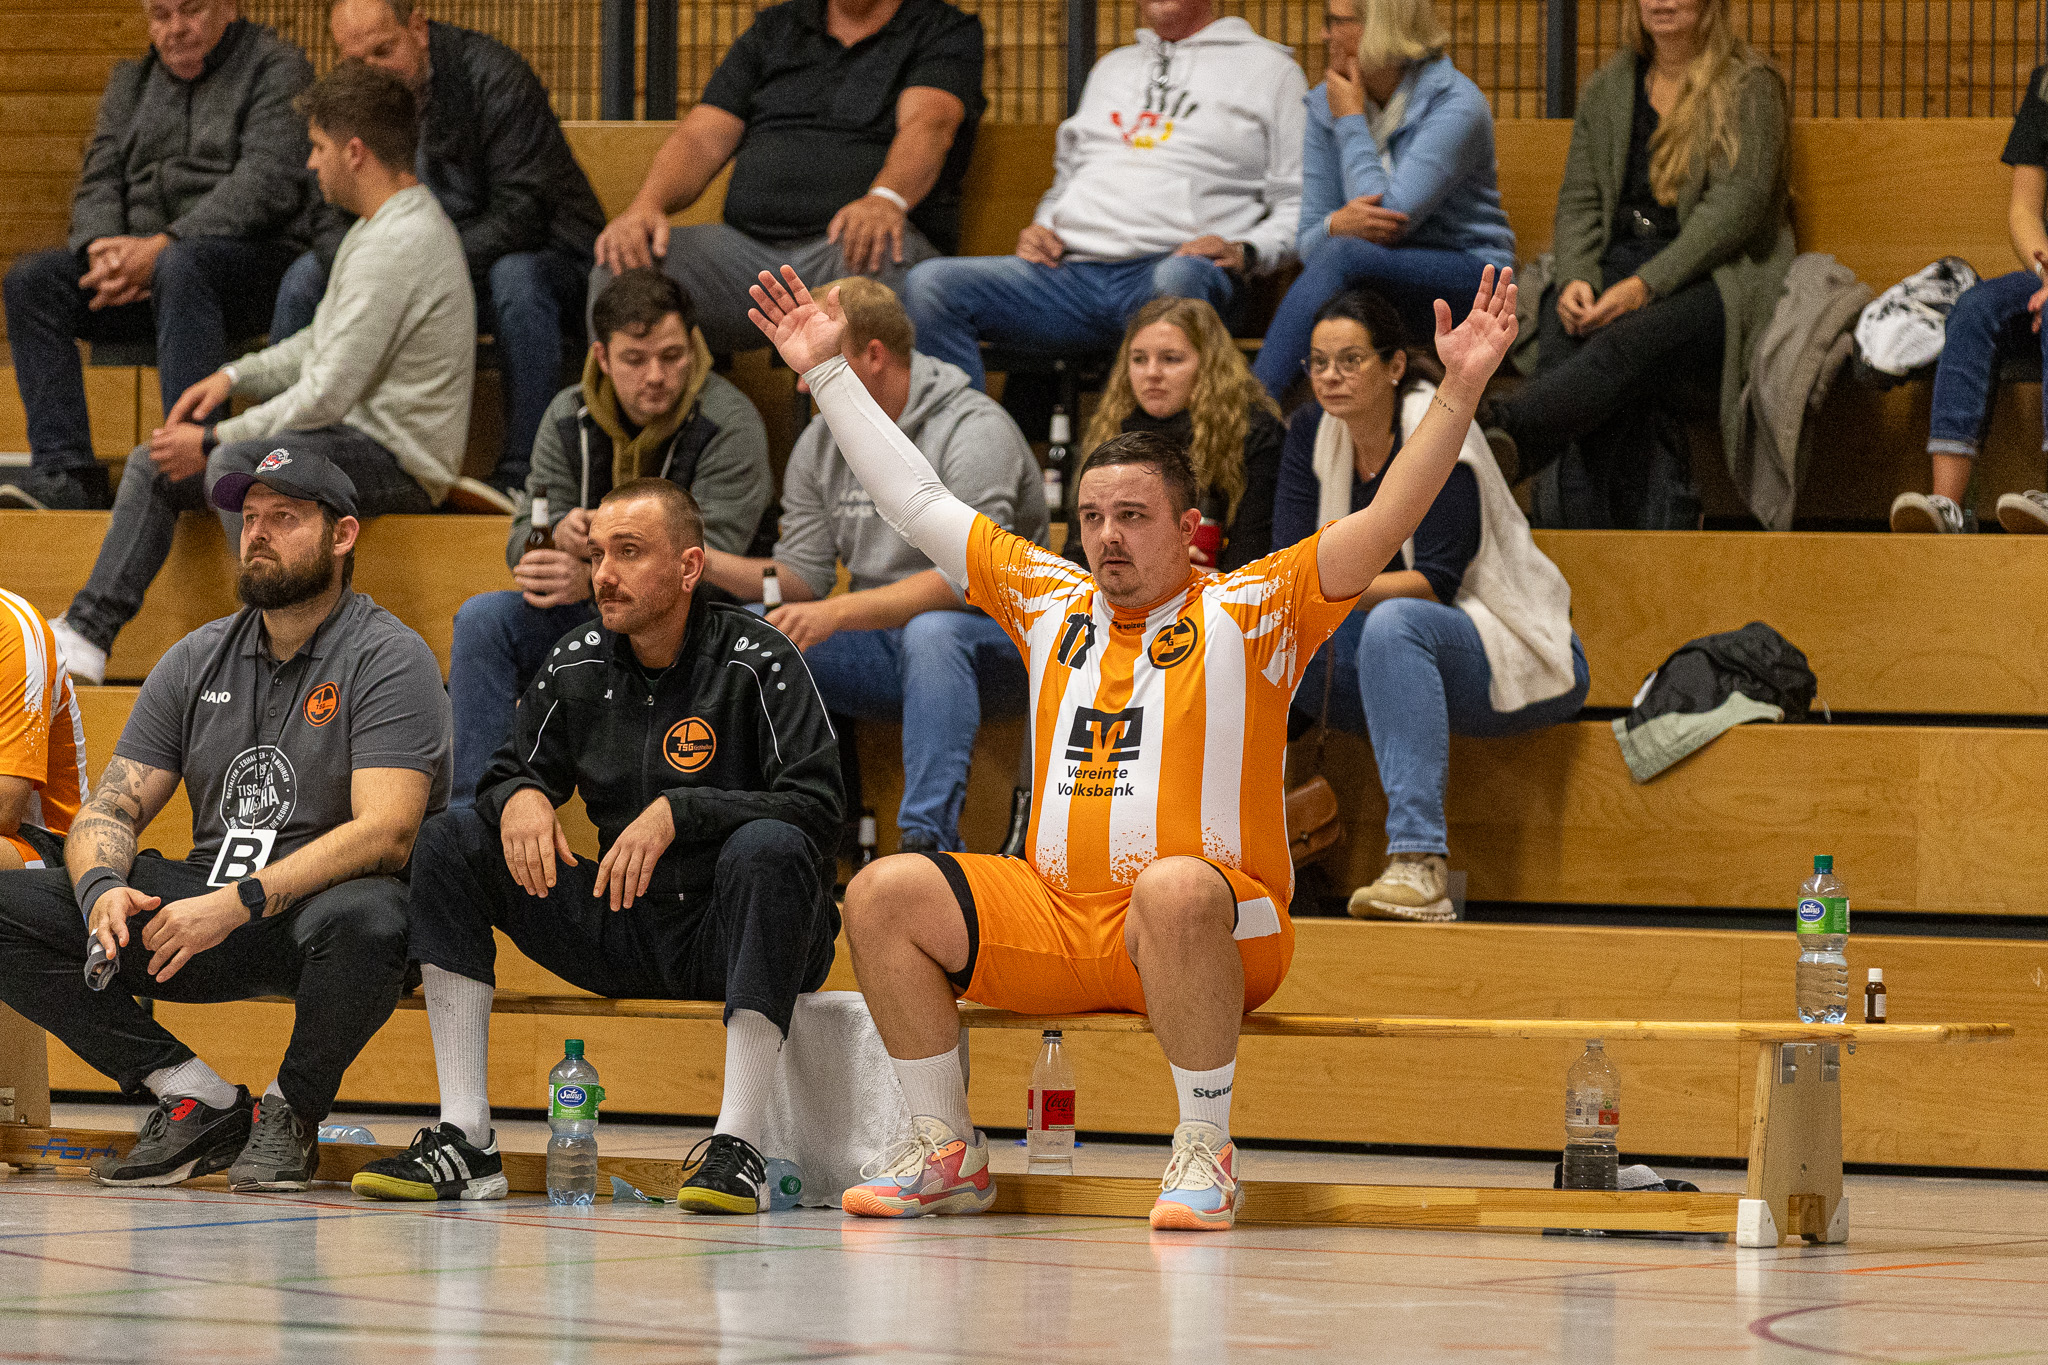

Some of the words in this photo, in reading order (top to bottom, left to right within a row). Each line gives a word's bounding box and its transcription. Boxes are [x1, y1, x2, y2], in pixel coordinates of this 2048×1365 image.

[677, 743, 694, 752] TSG
[226, 768, 240, 800] GESTALTEN
[240, 752, 266, 768] ERHALEN
[1067, 765, 1128, 779] Vereinte
[1058, 782, 1135, 797] Volksbank
[213, 836, 263, 884] B
